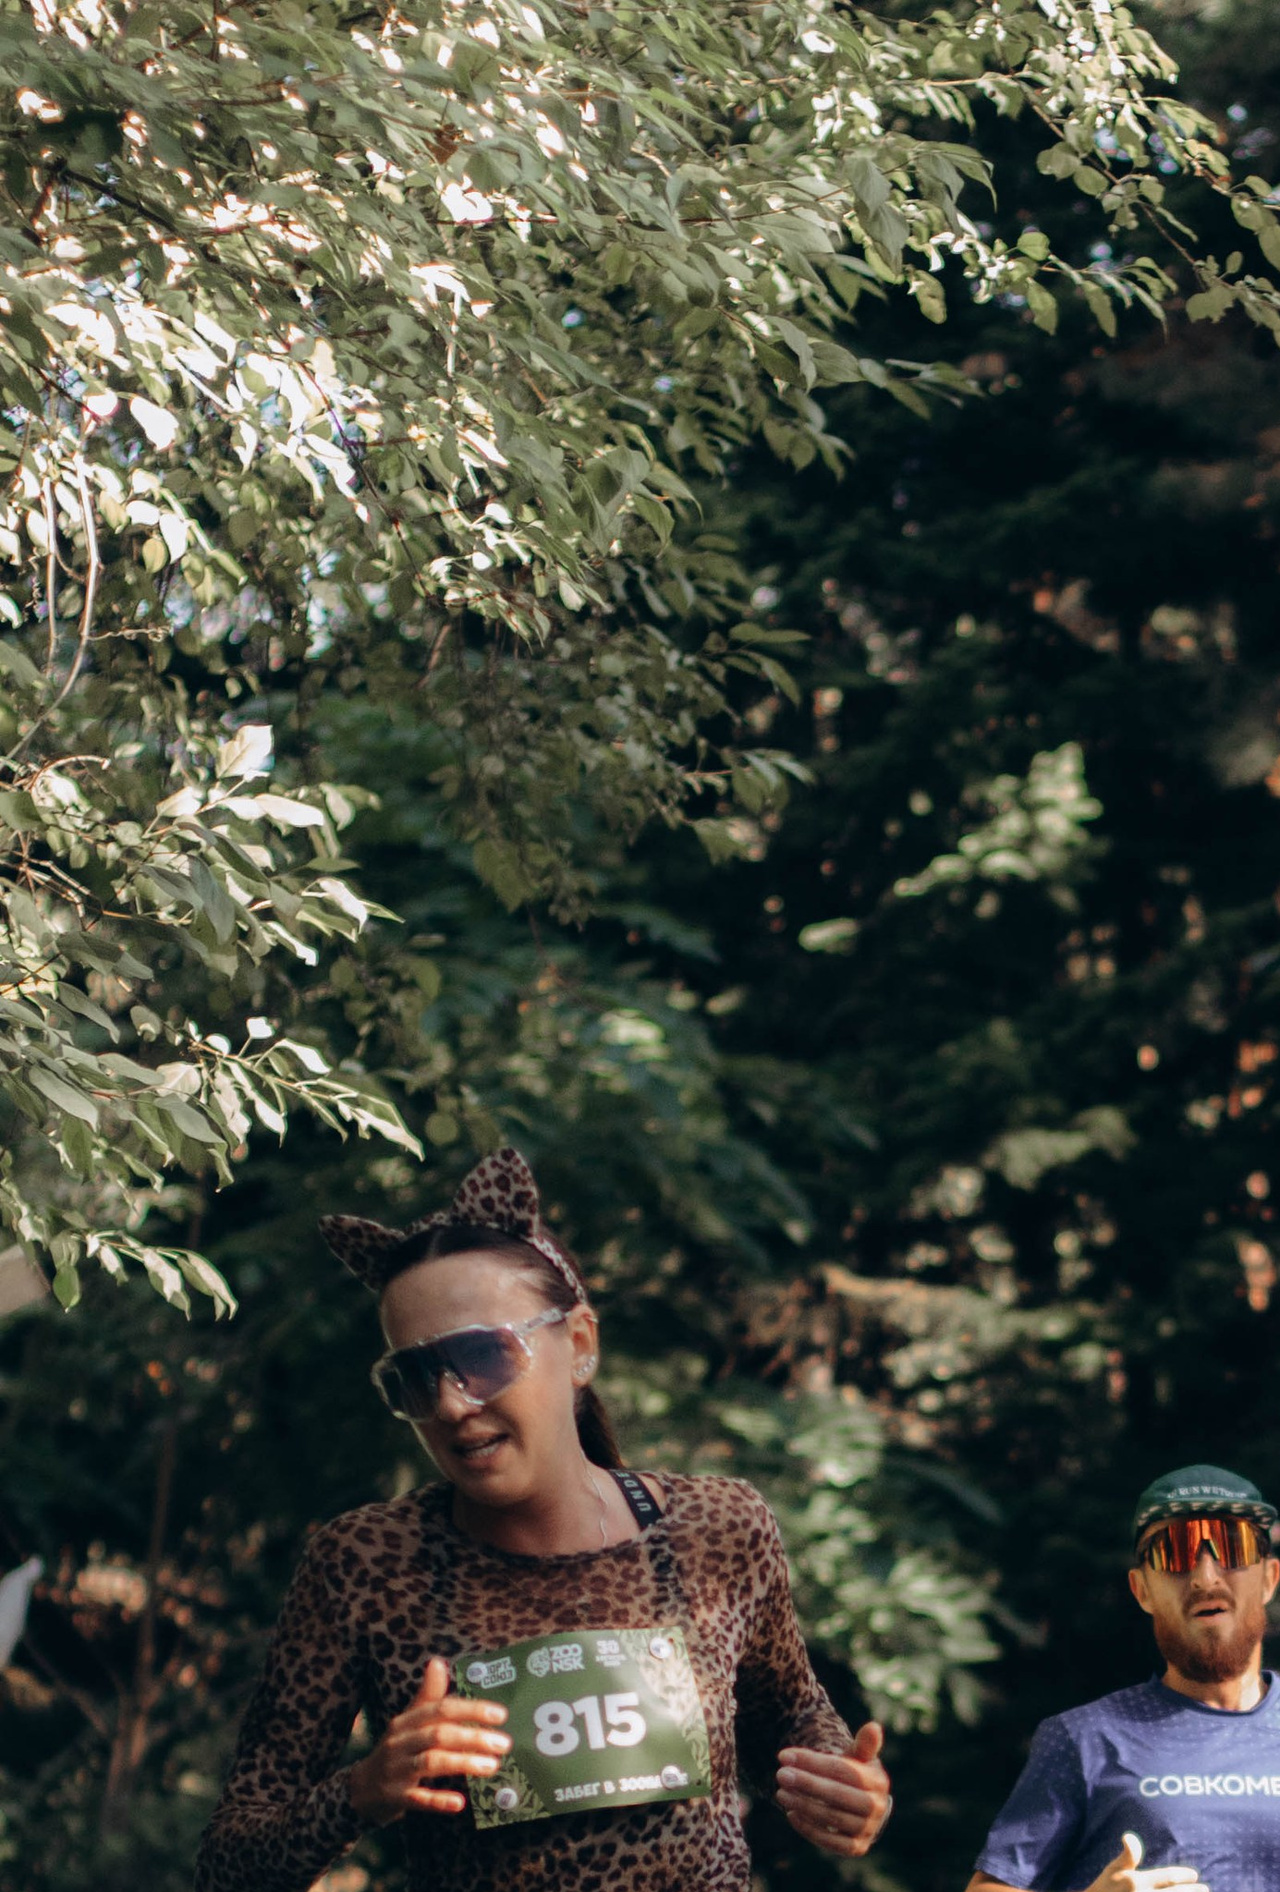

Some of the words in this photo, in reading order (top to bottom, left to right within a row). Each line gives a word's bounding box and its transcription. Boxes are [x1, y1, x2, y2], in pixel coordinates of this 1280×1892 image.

[550, 1643, 582, 1660] ZOO
[552, 1656, 585, 1673] NSK
[533, 1691, 647, 1757] 815
[554, 1781, 601, 1802] ЗАБЕГ
[603, 1780, 616, 1794] В
